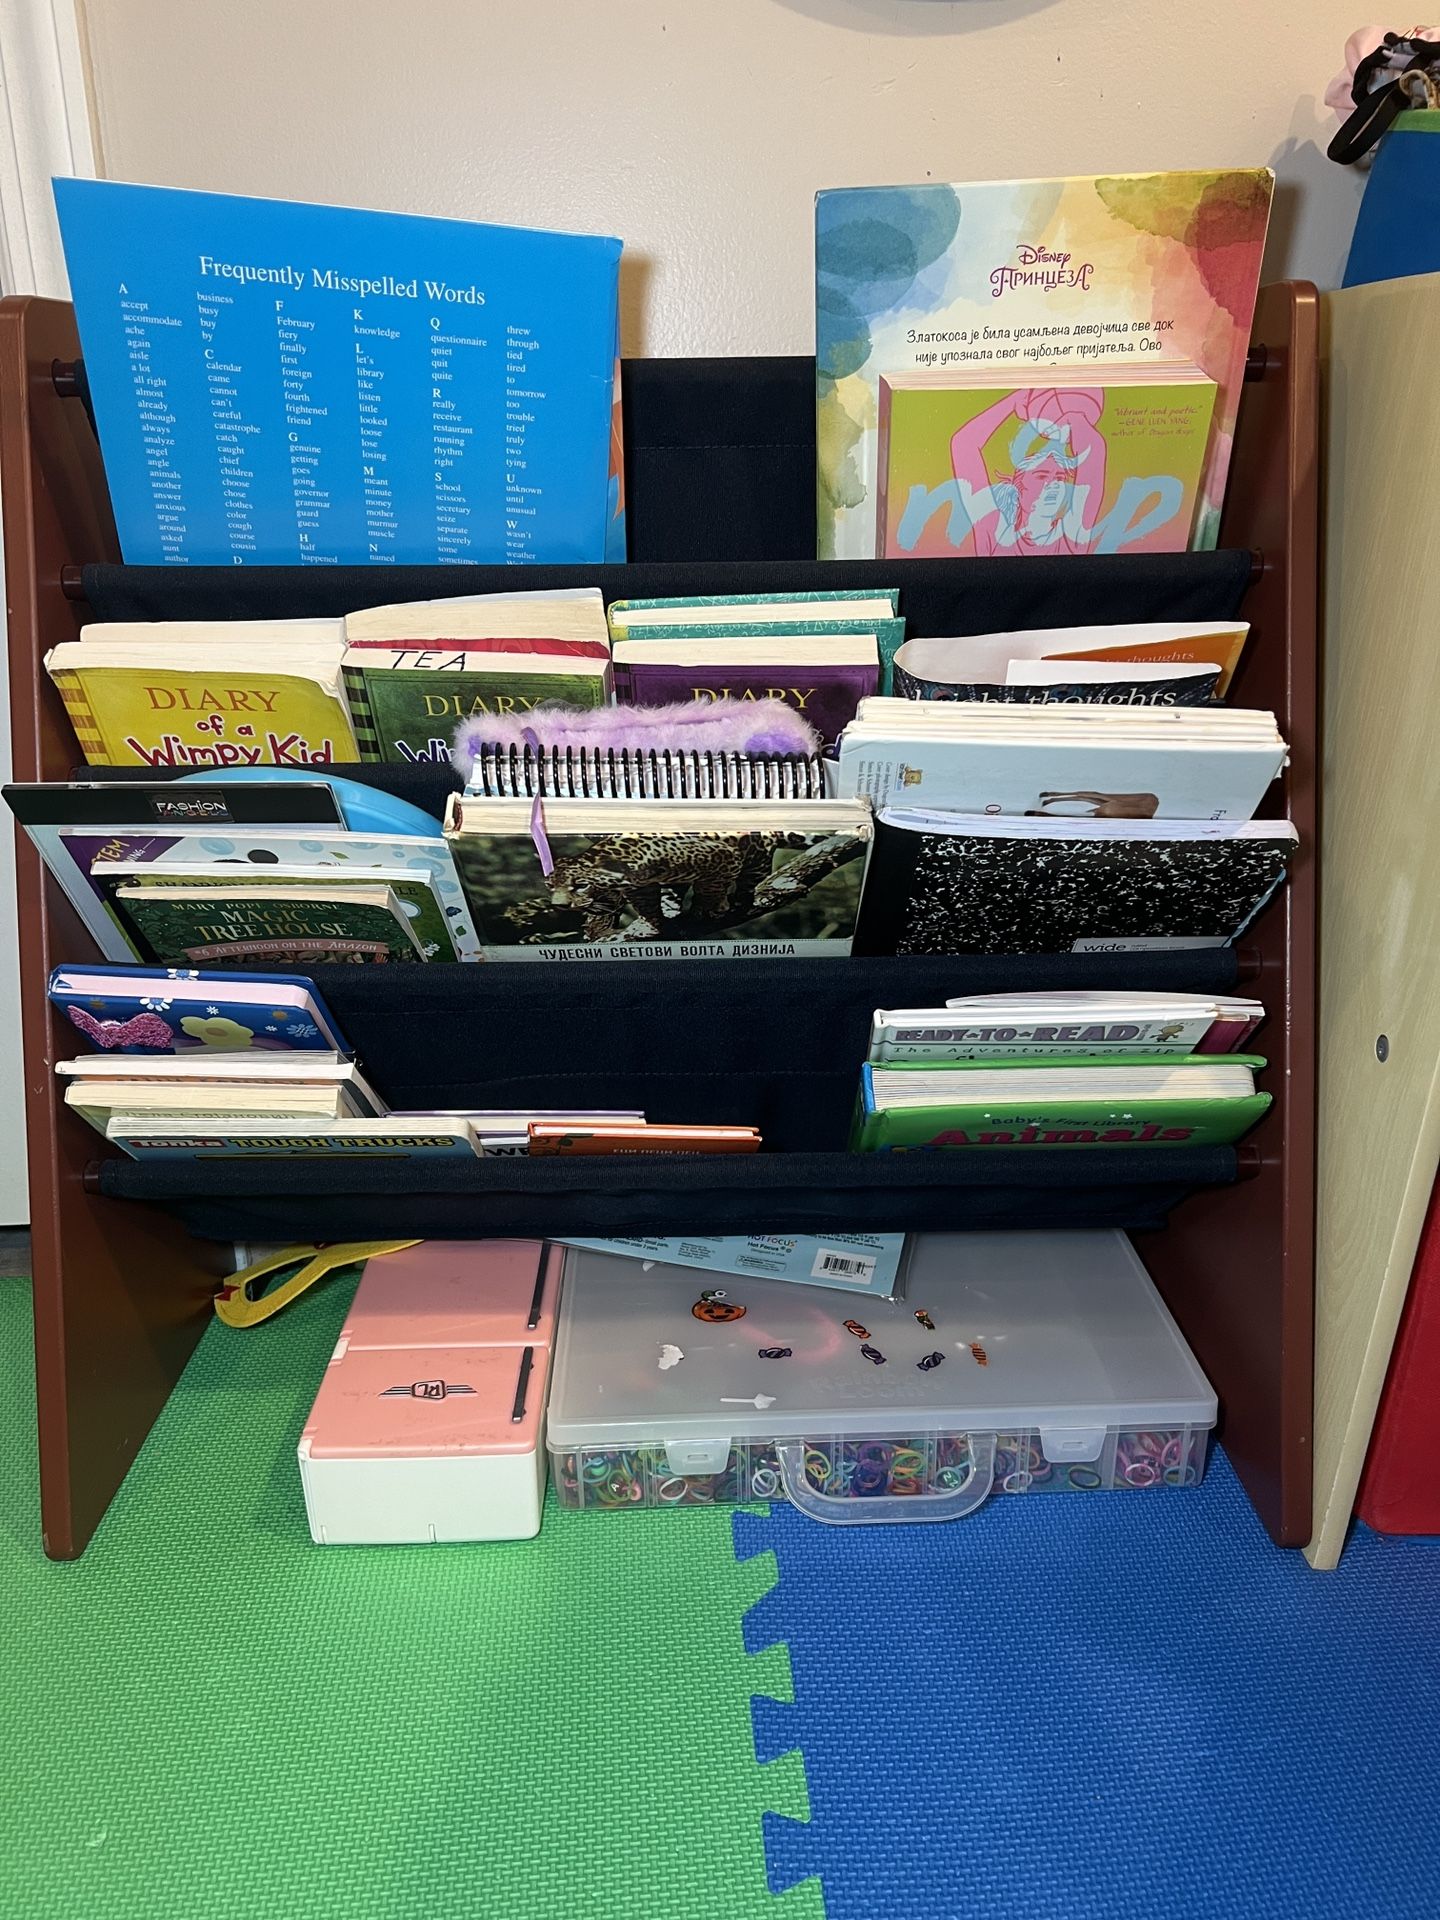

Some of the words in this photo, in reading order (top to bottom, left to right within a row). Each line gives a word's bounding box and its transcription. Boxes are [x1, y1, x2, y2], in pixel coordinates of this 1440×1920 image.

[1016, 244, 1071, 269] Disney
[198, 255, 305, 291] Frequently
[311, 267, 419, 299] Misspelled
[423, 280, 486, 306] Words
[118, 282, 129, 295] A
[196, 291, 234, 304] business
[120, 300, 149, 312] accept
[198, 304, 219, 318] busy
[274, 299, 284, 312] F
[122, 314, 183, 327] accommodate
[353, 308, 364, 321] K
[199, 317, 217, 330] buy
[276, 315, 316, 332] February
[429, 316, 441, 331] Q
[124, 325, 145, 336] ache
[201, 330, 214, 343] by
[278, 329, 298, 342] fiery
[353, 324, 401, 340] knowledge
[506, 325, 531, 336] threw
[907, 329, 967, 343] Златокоса
[967, 329, 980, 345] је
[983, 325, 1011, 340] била
[1013, 326, 1070, 342] усамљена
[1073, 322, 1128, 338] девојчица
[1131, 321, 1151, 331] све
[1153, 320, 1174, 332] док
[127, 339, 151, 349] again
[430, 334, 488, 347] questionnaire
[506, 337, 540, 351] through
[204, 348, 215, 360] C
[279, 341, 307, 355] finally
[355, 342, 364, 354] L
[430, 347, 453, 357] quiet
[916, 351, 938, 367] није
[941, 350, 993, 365] упознала
[996, 348, 1020, 359] свог
[1023, 343, 1073, 361] најбољег
[1076, 342, 1136, 358] пријатеља.
[1139, 338, 1162, 351] Ово
[129, 351, 150, 361] aisle
[280, 354, 298, 365] first
[355, 354, 374, 365] let's
[506, 350, 523, 360] tied
[139, 363, 151, 372] lot
[205, 361, 242, 373] calendar
[431, 359, 449, 369] quit
[506, 363, 526, 373] tired
[207, 374, 231, 383] came
[282, 366, 313, 380] foreign
[356, 367, 385, 381] library
[431, 371, 453, 382] quite
[134, 375, 144, 384] all
[146, 377, 167, 387] right
[283, 379, 304, 392] forty
[357, 379, 374, 390] like
[506, 376, 516, 384] to
[135, 387, 164, 398] almost
[209, 387, 238, 396] cannot
[284, 391, 311, 402] fourth
[358, 391, 381, 402] listen
[432, 387, 442, 399] R
[506, 388, 547, 399] tomorrow
[137, 399, 168, 412] already
[210, 398, 232, 408] can't
[359, 403, 378, 414] little
[432, 400, 456, 411] really
[506, 400, 520, 409] too
[212, 410, 242, 420] careful
[285, 403, 328, 416] frightened
[139, 411, 177, 424] although
[286, 415, 312, 426] friend
[359, 415, 388, 427] looked
[432, 412, 462, 422] receive
[506, 412, 536, 422] trouble
[214, 423, 261, 435] catastrophe
[433, 424, 473, 435] restaurant
[506, 424, 525, 433] tried
[288, 431, 298, 443] G
[433, 436, 465, 447] running
[506, 435, 526, 447] truly
[433, 446, 463, 457] rhythm
[434, 458, 454, 468] right
[363, 465, 375, 476] M
[434, 471, 442, 482] S
[506, 473, 516, 484] U
[506, 519, 518, 530] W
[299, 533, 309, 543] H
[368, 543, 378, 553] N
[233, 555, 243, 565] D
[391, 651, 466, 671] TEA
[144, 687, 281, 712] DIARY
[422, 695, 542, 717] DIARY
[197, 714, 224, 736] of
[238, 725, 255, 736] a
[126, 735, 262, 766] Wimpy
[268, 733, 332, 765] Kid
[171, 903, 216, 911] MARY
[219, 910, 309, 923] MAGIC
[194, 923, 263, 941] TREE
[263, 922, 353, 937] HOUSE
[539, 949, 603, 962] ЧУДЕСНИ
[610, 947, 673, 958] СВЕТОВИ
[680, 945, 725, 956] ВОЛТА
[732, 944, 796, 957] ДИЗНИЈА
[1083, 944, 1126, 952] wide
[949, 1046, 1091, 1054] Adventures
[991, 1116, 1049, 1126] Baby's
[1055, 1117, 1089, 1127] First
[1091, 1118, 1152, 1128] Library
[928, 1124, 1197, 1146] Animals
[130, 1138, 222, 1148] Tonka
[227, 1137, 330, 1148] TOUGH
[332, 1136, 455, 1148] TRUCKS
[760, 1243, 779, 1252] Focus
